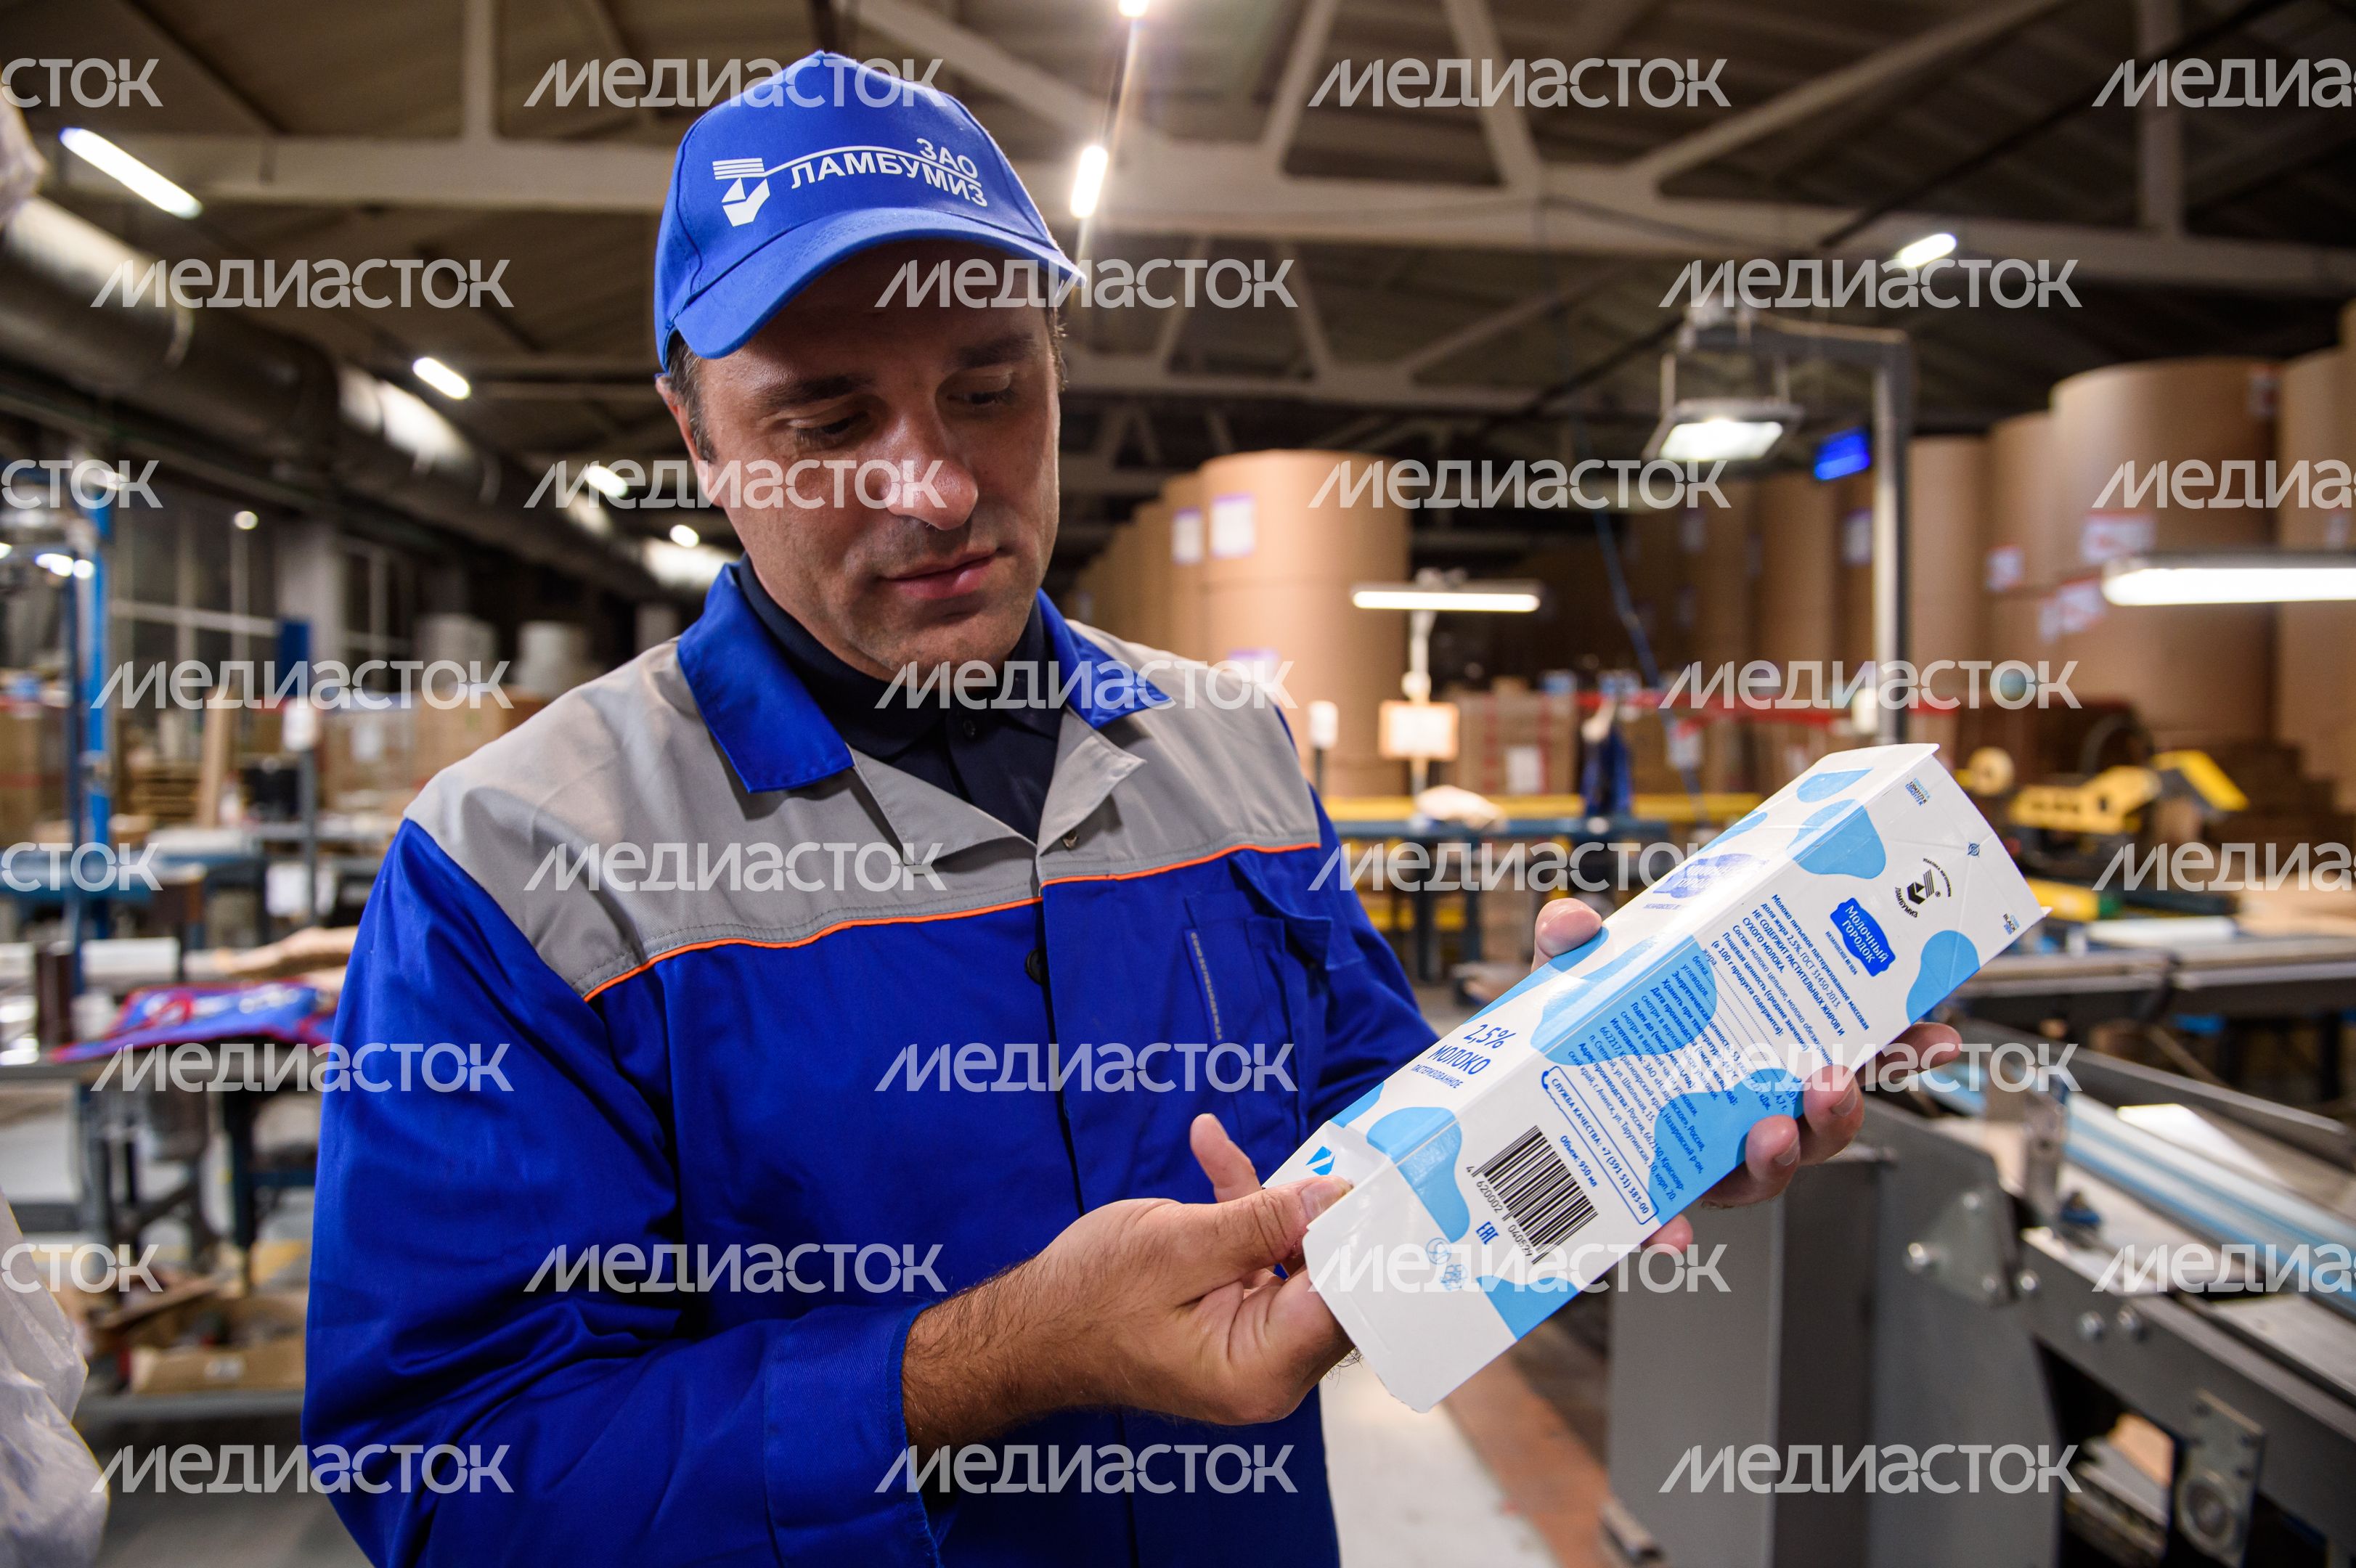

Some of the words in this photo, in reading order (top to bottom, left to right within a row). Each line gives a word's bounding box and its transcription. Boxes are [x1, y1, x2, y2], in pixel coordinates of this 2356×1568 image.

[791, 152, 988, 208] ЛАМБУМИЗ
[916, 138, 979, 179] ЗАО
[1894, 887, 1917, 918] ЛАМБУМИЗ
[2002, 912, 2017, 933] BLACK
[1731, 923, 1753, 950] Состав:
[1749, 947, 1770, 973] молоко
[1765, 971, 1790, 1002] цельное,
[1785, 999, 1806, 1024] молоко
[1741, 915, 1764, 944] СУХОГО
[1760, 941, 1787, 974] МОЛОКА.
[1751, 908, 1763, 920] НЕ
[1758, 918, 1789, 956] СОДЕРЖИТ
[1784, 953, 1825, 1006] РАСТИТЕЛЬНЫХ
[1819, 1003, 1841, 1030] ЖИРОВ
[1835, 1027, 1846, 1037] И
[1760, 901, 1777, 920] доля
[1772, 917, 1790, 937] жира
[1798, 952, 1815, 971] ГОСТ
[1810, 969, 1842, 1010] 31450-2013.
[1771, 893, 1793, 920] Молоко
[1789, 918, 1814, 950] питьевое
[1809, 947, 1851, 1002] пастеризованное
[1846, 1000, 1870, 1031] массовая
[1710, 939, 1721, 950] (в
[1717, 947, 1732, 963] 100
[1728, 964, 1755, 997] продукта
[1750, 993, 1785, 1037] содержится):
[1721, 931, 1747, 963] Пищевая
[1742, 960, 1768, 992] ценность
[1762, 989, 1789, 1021] (средние
[1463, 1022, 1517, 1050] 2,5%
[1588, 1034, 1597, 1043] п.
[1630, 1001, 1648, 1023] Годен
[1643, 1020, 1655, 1033] до
[1650, 985, 1667, 1005] Дата
[1662, 1002, 1698, 1048] производства
[1660, 978, 1685, 1008] Хранить
[1679, 1005, 1693, 1021] при
[1687, 1017, 1724, 1063] температуре:
[1671, 969, 1712, 1022] Энергетическая
[1706, 1019, 1735, 1053] ценность:
[1411, 1063, 1463, 1089] ПАСТЕРИЗОВАННОЕ
[1427, 1044, 1491, 1074] МОЛОКО
[1591, 1039, 1619, 1071] Степной,
[1612, 1068, 1625, 1081] ул.
[1618, 1010, 1641, 1036] смотри
[1639, 1037, 1665, 1069] верхней
[1660, 1066, 1677, 1086] части
[1672, 1084, 1700, 1118] упаковки.
[1639, 994, 1661, 1020] смотри
[1660, 1022, 1685, 1053] верхней
[1692, 1068, 1719, 1102] упаковки.
[1598, 1024, 1622, 1054] 662217,
[1616, 1050, 1655, 1098] Красноярский
[1648, 1095, 1668, 1116] край,
[1660, 1112, 1695, 1157] Назаровский
[1688, 1154, 1705, 1175] р-он,
[1609, 1017, 1647, 1066] Изготовитель:
[1642, 1061, 1657, 1079] ЗАО
[1684, 1125, 1708, 1152] Россия,
[1619, 1077, 1650, 1114] Школьная,
[1549, 1077, 1576, 1109] СЛУЖБА
[1571, 1106, 1604, 1148] КАЧЕСТВА:
[1599, 1145, 1611, 1158] +7
[1605, 1155, 1623, 1175] (391
[1617, 1172, 1633, 1190] 51)
[1626, 1185, 1650, 1214] 383-00
[1566, 1049, 1584, 1069] ский
[1578, 1065, 1596, 1085] край,
[1594, 1087, 1617, 1115] Ачинск,
[1611, 1112, 1623, 1124] ул.
[1617, 1121, 1652, 1165] Тарутинская,
[1645, 1161, 1659, 1175] 10,
[1652, 1172, 1670, 1193] корп.
[1664, 1188, 1677, 1202] 20.
[1576, 1041, 1597, 1066] Адрес
[1591, 1061, 1630, 1111] производства:
[1624, 1107, 1647, 1135] Россия,
[1640, 1131, 1666, 1161] 662150,
[1657, 1156, 1687, 1193] Краснояр-
[1644, 1110, 1657, 1124] 15.
[1464, 1164, 1475, 1174] 4
[1475, 1178, 1504, 1214] 620002
[1557, 1134, 1583, 1164] Объем:
[1576, 1159, 1592, 1177] 950
[1586, 1175, 1599, 1188] мл
